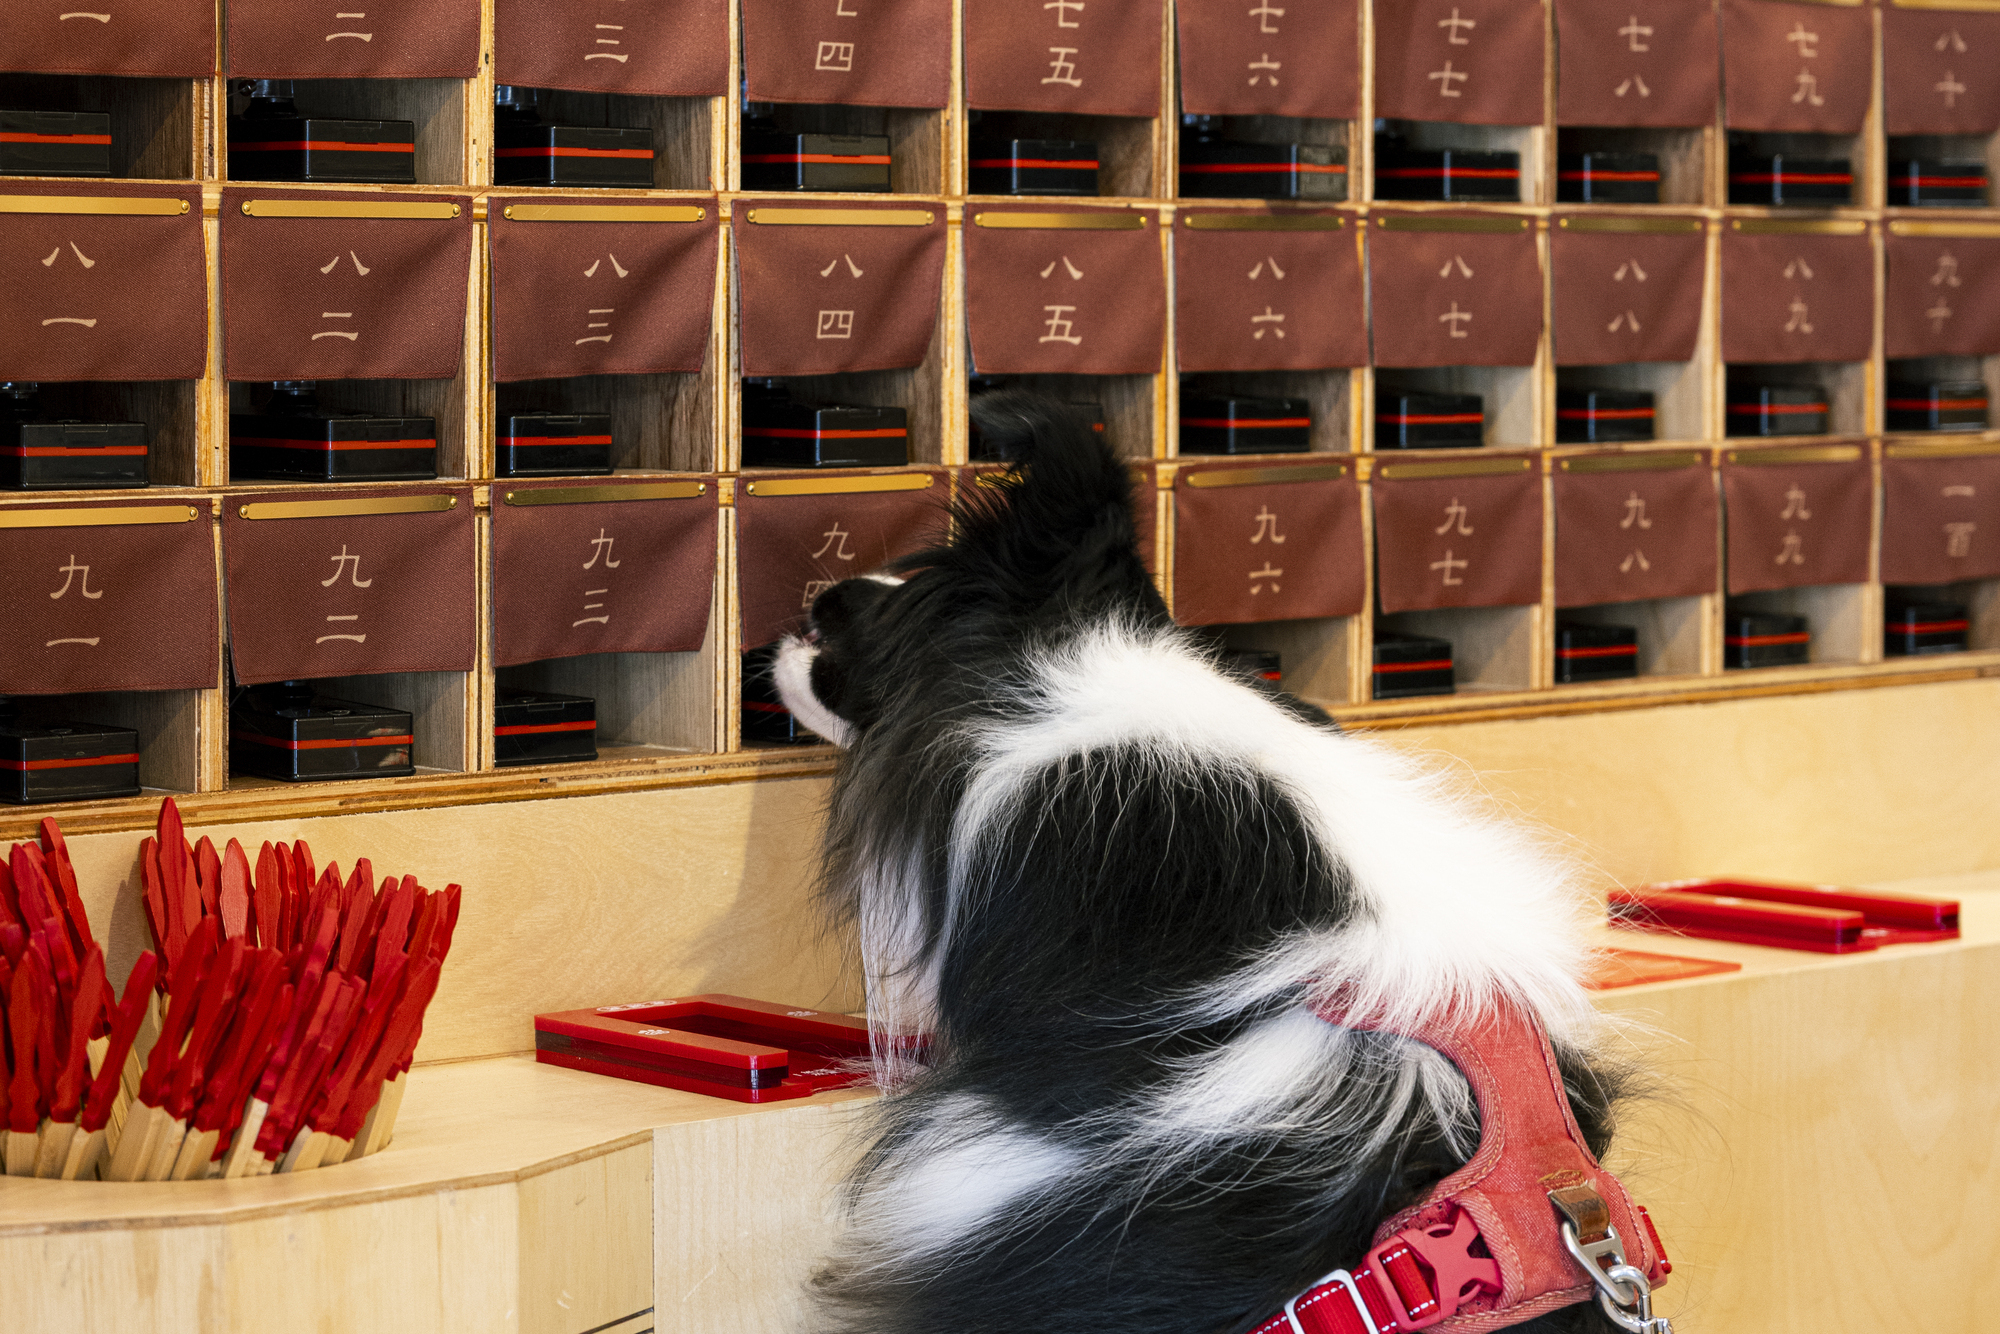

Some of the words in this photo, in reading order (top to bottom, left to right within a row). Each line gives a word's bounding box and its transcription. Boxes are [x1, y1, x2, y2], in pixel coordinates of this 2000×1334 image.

[1042, 0, 1085, 87] 七五
[1249, 0, 1284, 86] 七六
[1428, 7, 1476, 98] 七七
[1615, 15, 1654, 97] 七八
[1786, 22, 1824, 106] 七九
[1934, 29, 1967, 107] 八十
[42, 242, 96, 327] 八一
[312, 251, 370, 341] 八二
[576, 254, 628, 344] 八三
[817, 254, 863, 339] 八四
[1039, 258, 1083, 345] 八五
[1248, 256, 1285, 340] 八六
[1439, 255, 1474, 338] 八七
[1607, 260, 1648, 333] 八八
[1783, 256, 1814, 334] 八九
[1248, 504, 1286, 595] 九六
[1429, 497, 1474, 587] 九七
[1619, 491, 1652, 572] 九八
[1775, 482, 1812, 565] 九九
[1941, 484, 1976, 558] 一百
[46, 554, 102, 646] 九一
[316, 545, 372, 643] 九二
[573, 528, 620, 627] 九三
